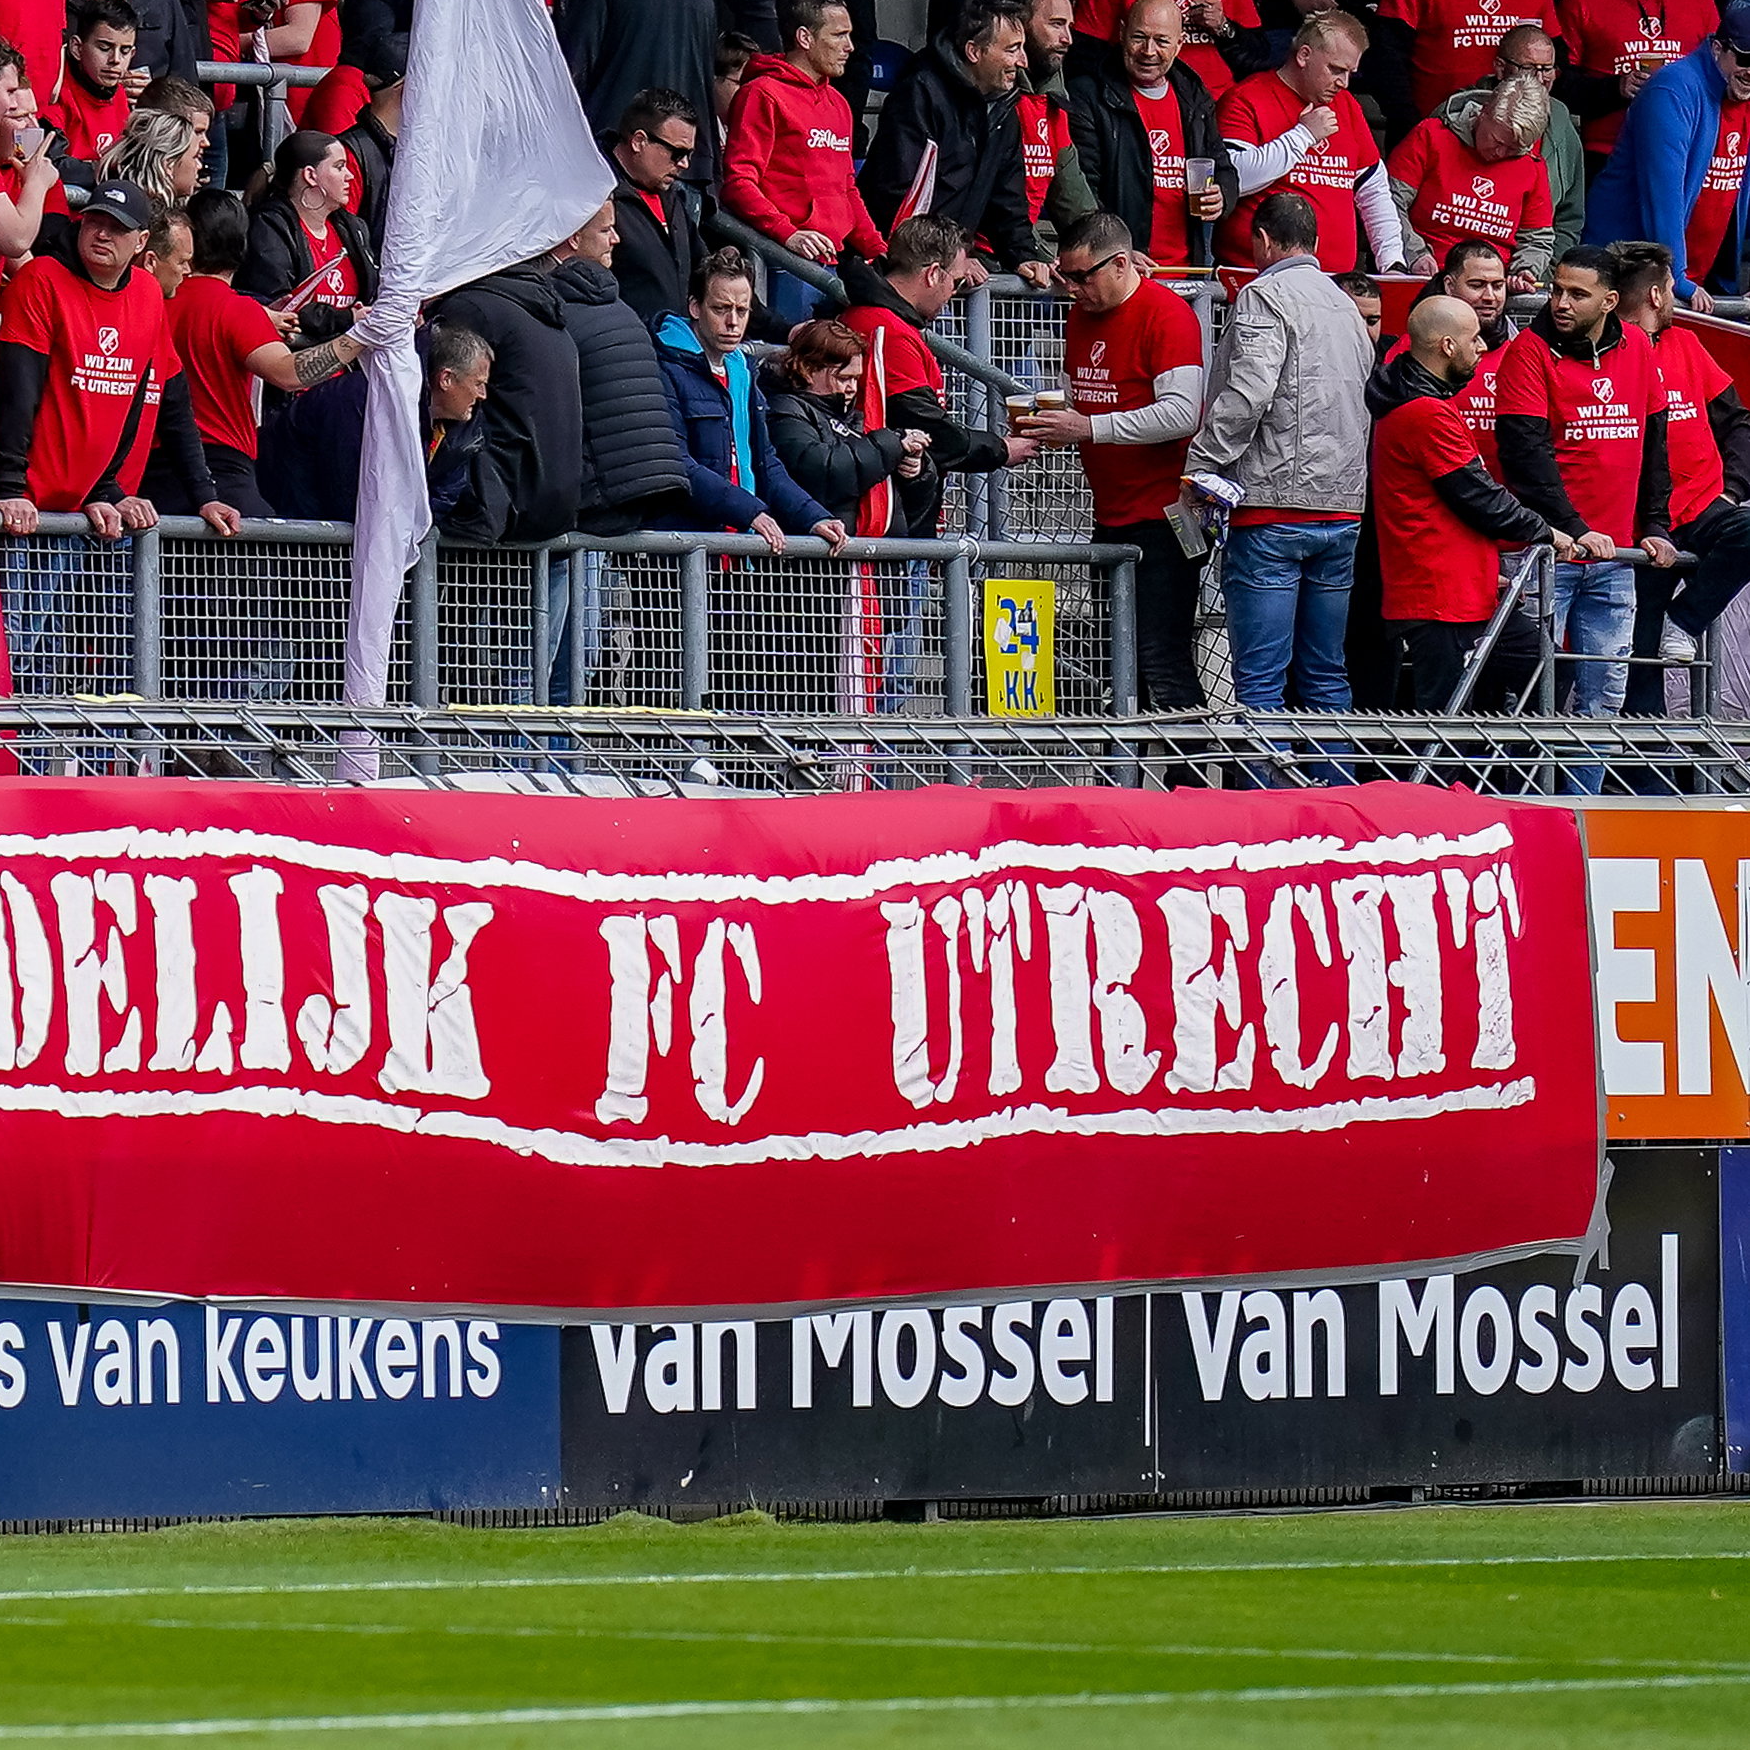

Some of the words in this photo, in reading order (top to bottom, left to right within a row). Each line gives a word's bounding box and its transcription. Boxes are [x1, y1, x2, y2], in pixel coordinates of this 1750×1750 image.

[1466, 15, 1488, 26] WIJ
[1492, 16, 1520, 26] ZIJN
[1454, 36, 1471, 48] FC
[1625, 41, 1649, 52] WIJ
[1653, 41, 1680, 52] ZIJN
[1615, 63, 1631, 74] FC
[1159, 156, 1185, 168] ZIJN
[1321, 156, 1347, 167] ZIJN
[1290, 172, 1306, 183] FC
[1310, 173, 1357, 189] UTRECHT
[1453, 193, 1477, 209] WIJ
[1479, 201, 1508, 219] ZIJN
[1432, 210, 1450, 223] FC
[1454, 214, 1513, 238] UTRECHT
[85, 354, 104, 369] WIJ
[106, 357, 132, 371] ZIJN
[1078, 367, 1092, 379] WIJ
[1092, 369, 1109, 380] ZIJN
[71, 376, 85, 390] FC
[88, 379, 136, 395] UTRECHT
[1078, 390, 1118, 403] UTRECHT
[1470, 397, 1494, 408] WIJ
[1577, 405, 1603, 418] WIJ
[1606, 404, 1628, 416] ZIJN
[1565, 429, 1583, 440] FC
[1586, 426, 1639, 439] UTRECHT
[1005, 670, 1039, 710] KK
[596, 912, 766, 1125] FC
[880, 858, 1521, 1110] UTRECHT
[1380, 1234, 1680, 1396] Mossel
[50, 1316, 180, 1407] van
[206, 1305, 501, 1403] keukens
[791, 1296, 1113, 1408] Mossel
